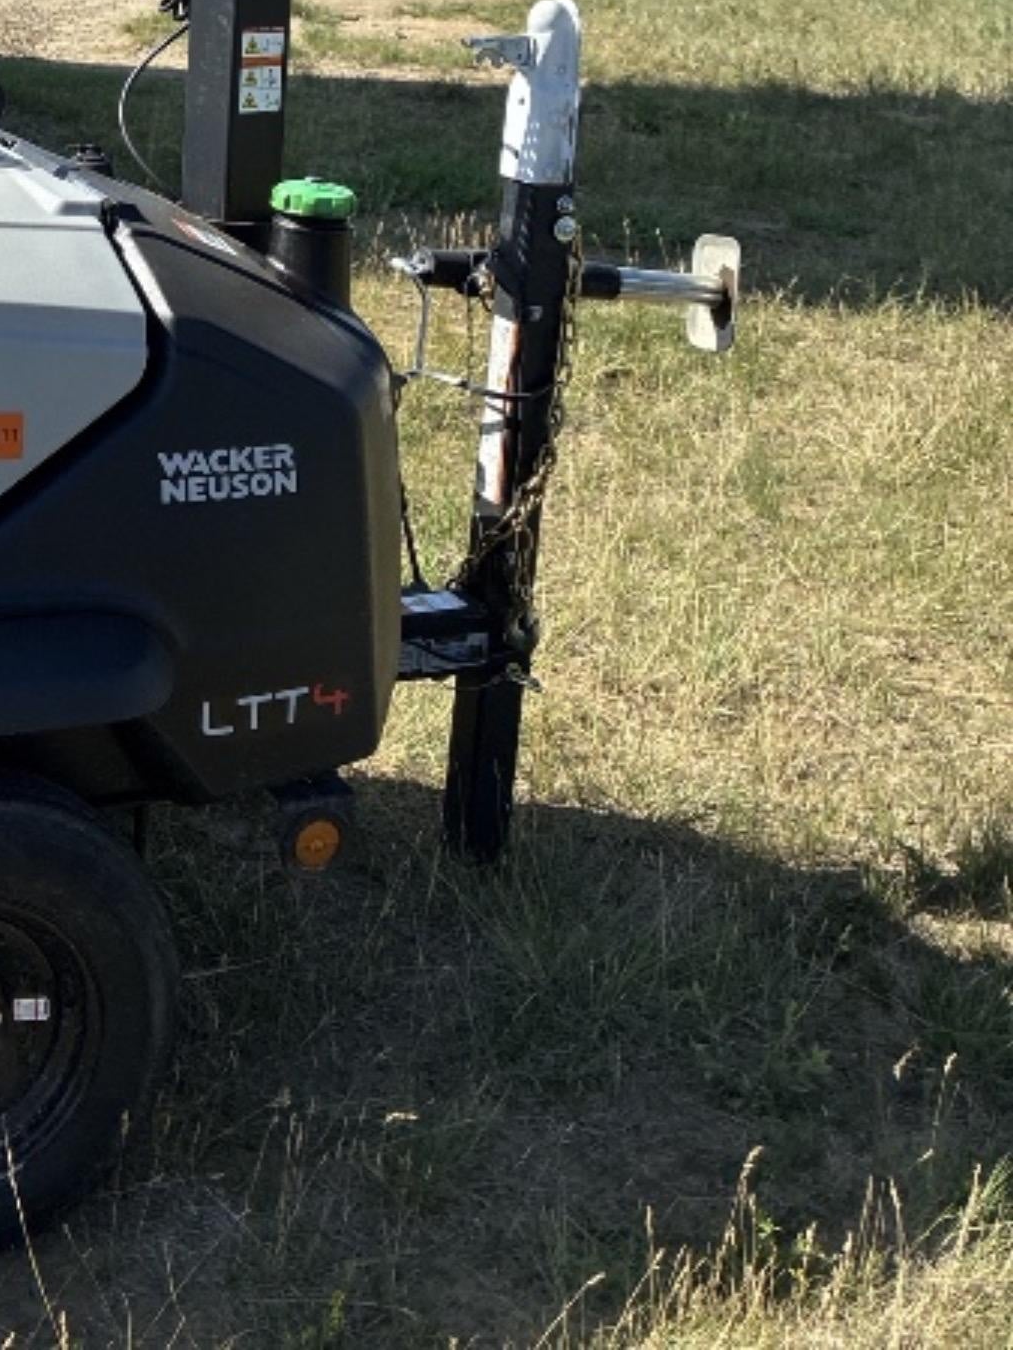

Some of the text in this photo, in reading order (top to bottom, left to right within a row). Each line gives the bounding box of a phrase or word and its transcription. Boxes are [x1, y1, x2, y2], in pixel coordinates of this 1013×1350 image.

[157, 443, 295, 477] WACKER
[160, 470, 297, 504] NEUSON
[202, 683, 349, 736] LTT4
